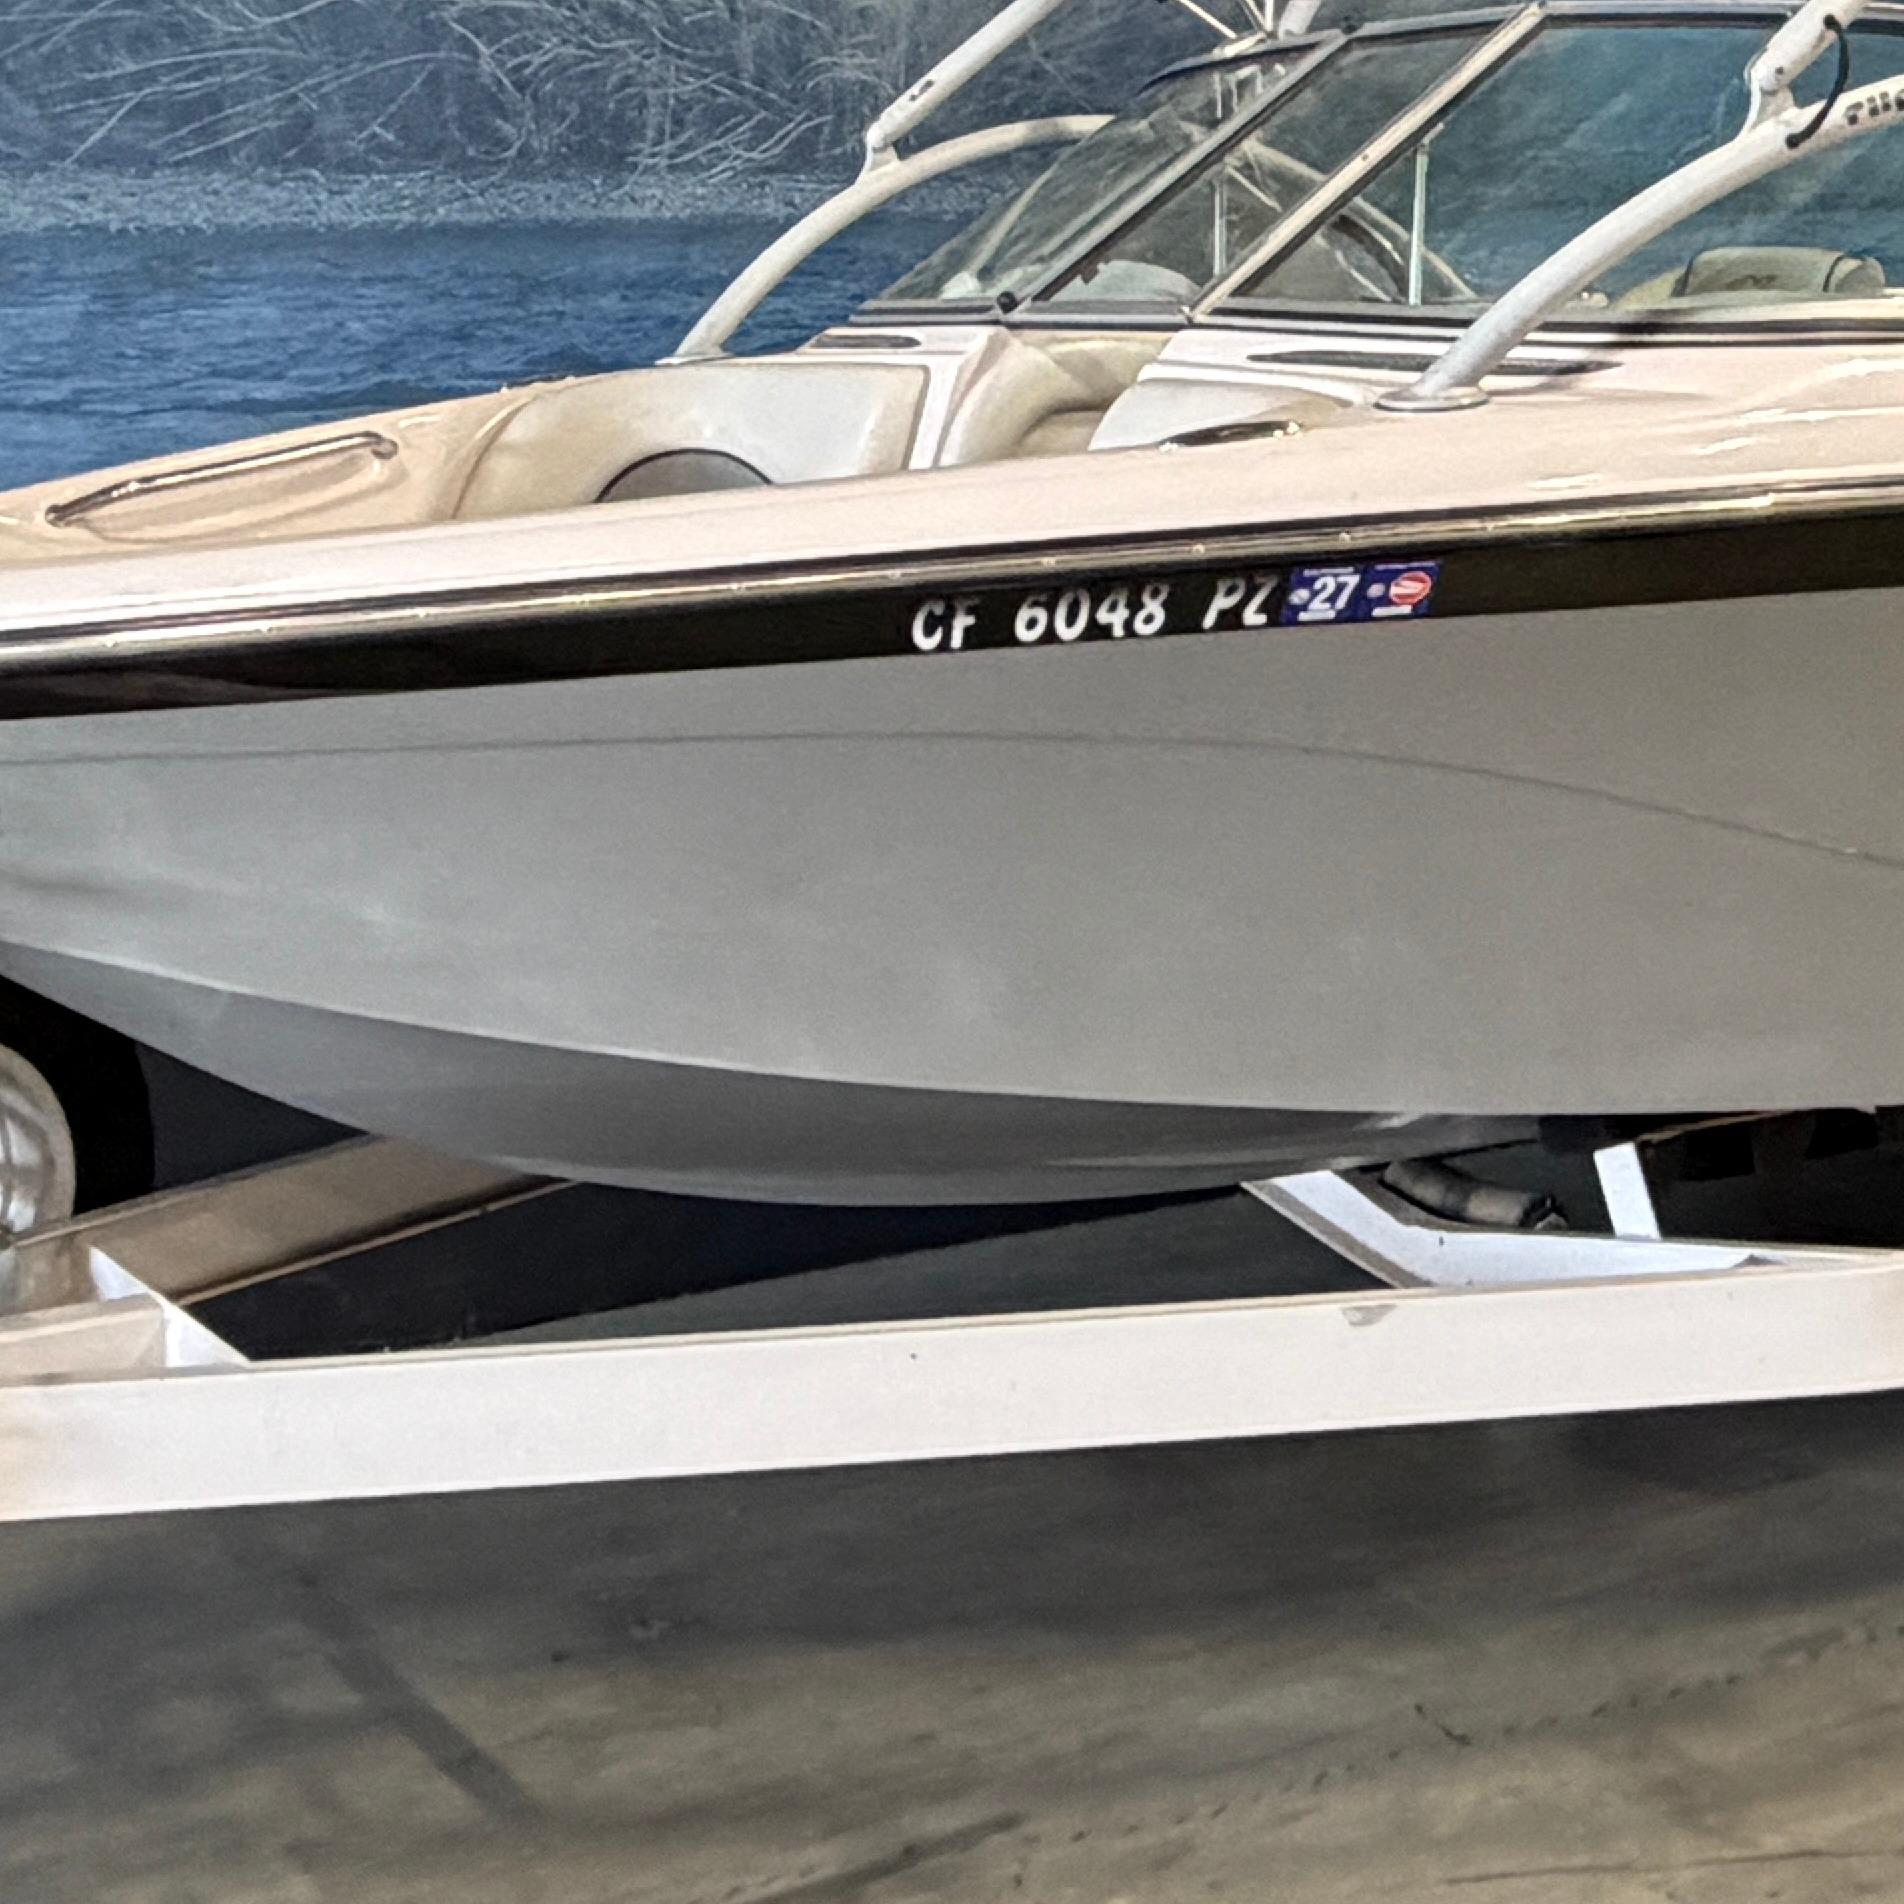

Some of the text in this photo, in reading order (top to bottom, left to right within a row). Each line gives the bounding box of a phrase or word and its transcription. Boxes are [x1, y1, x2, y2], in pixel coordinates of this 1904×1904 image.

[911, 597, 978, 652] CF
[1014, 581, 1171, 644] 6048
[1306, 573, 1361, 611] 27
